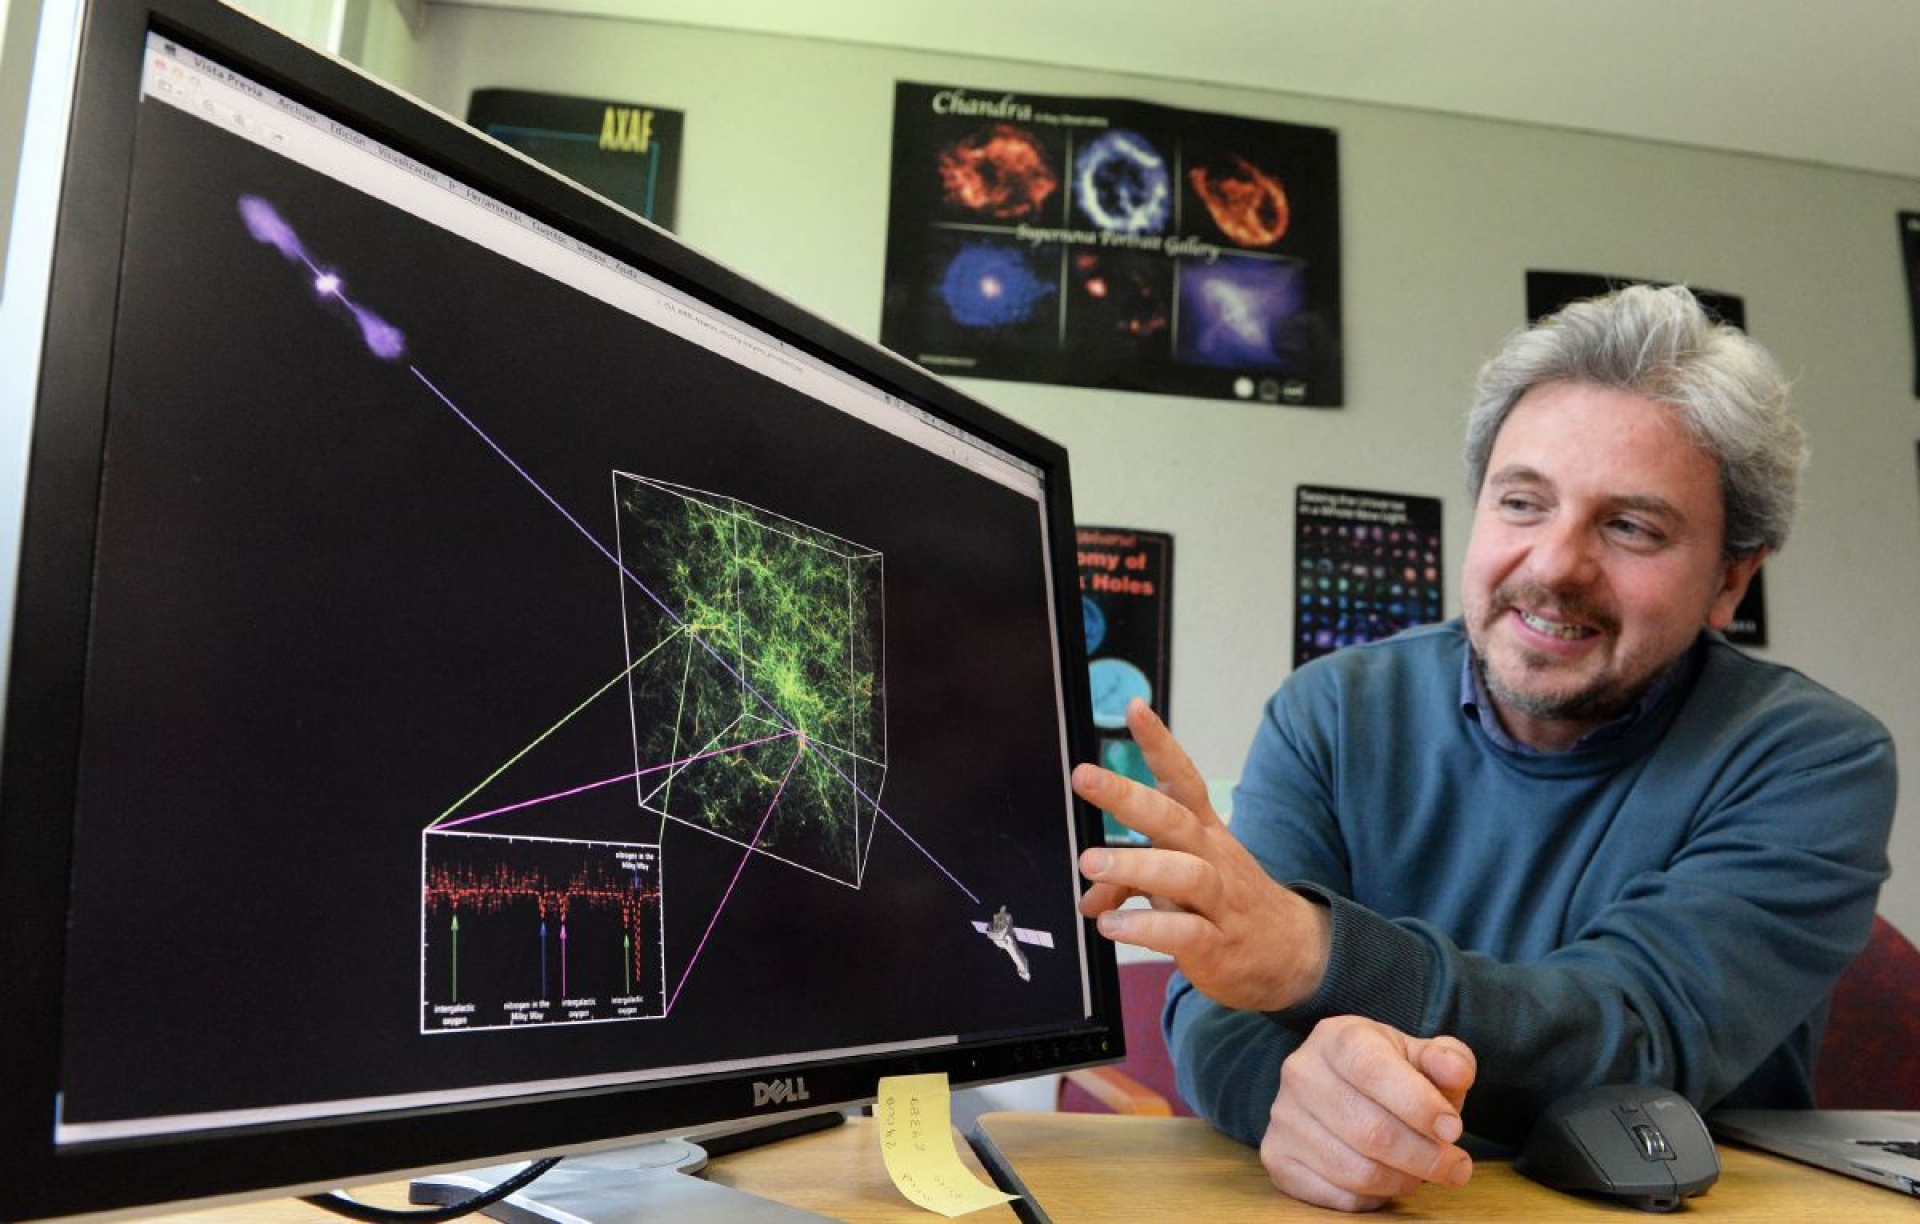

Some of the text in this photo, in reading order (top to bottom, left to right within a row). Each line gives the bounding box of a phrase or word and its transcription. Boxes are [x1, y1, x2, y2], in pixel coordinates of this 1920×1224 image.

[194, 57, 225, 81] Vista
[227, 69, 263, 98] Previa
[278, 97, 317, 124] Archivo
[933, 88, 1032, 121] Chandra
[599, 106, 655, 153] AXAF
[1016, 224, 1221, 265] Supernova Portrait Gallery
[1125, 552, 1146, 571] of
[1092, 573, 1154, 596] Holes
[753, 1077, 810, 1107] DELL
